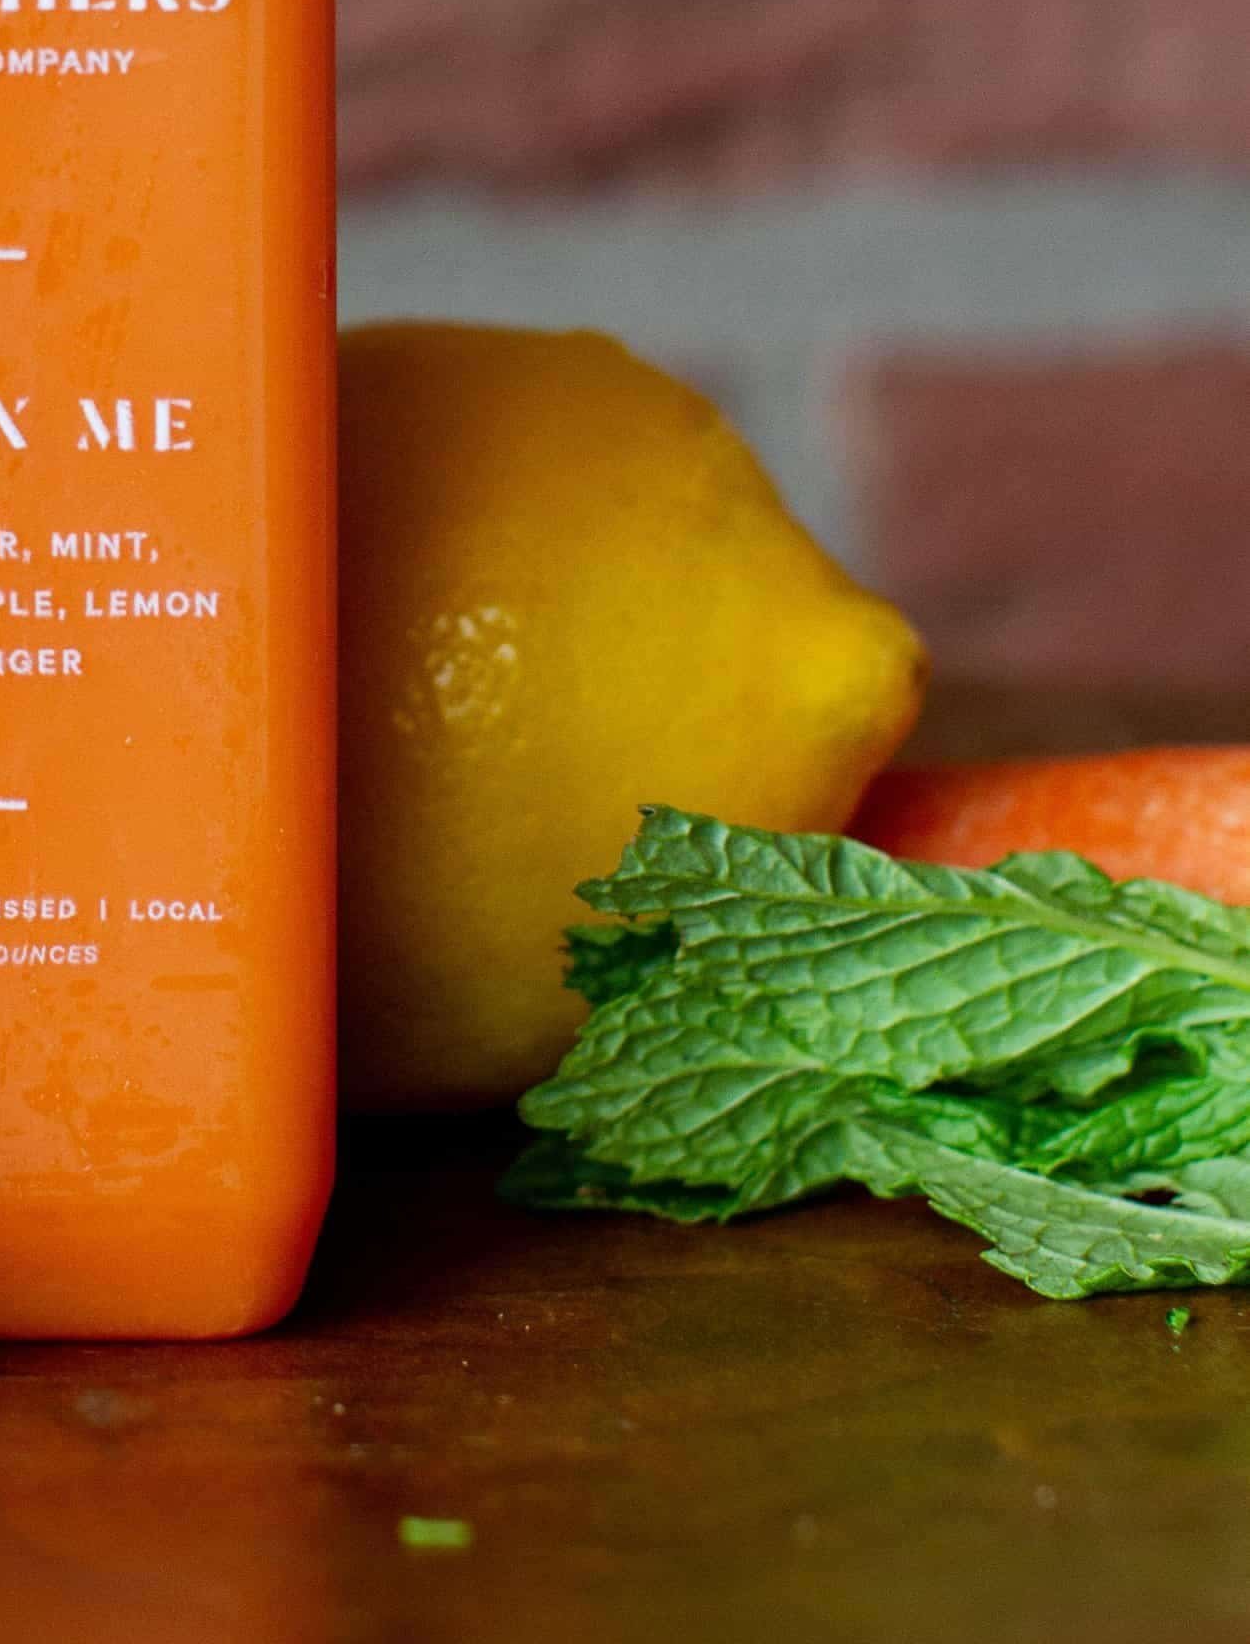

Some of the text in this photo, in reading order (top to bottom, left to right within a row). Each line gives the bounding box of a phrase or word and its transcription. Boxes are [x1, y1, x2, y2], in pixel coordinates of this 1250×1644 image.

[77, 397, 193, 453] ME
[50, 530, 159, 564] MINT,
[84, 589, 220, 619] LEMON
[129, 898, 223, 922] LOCAL
